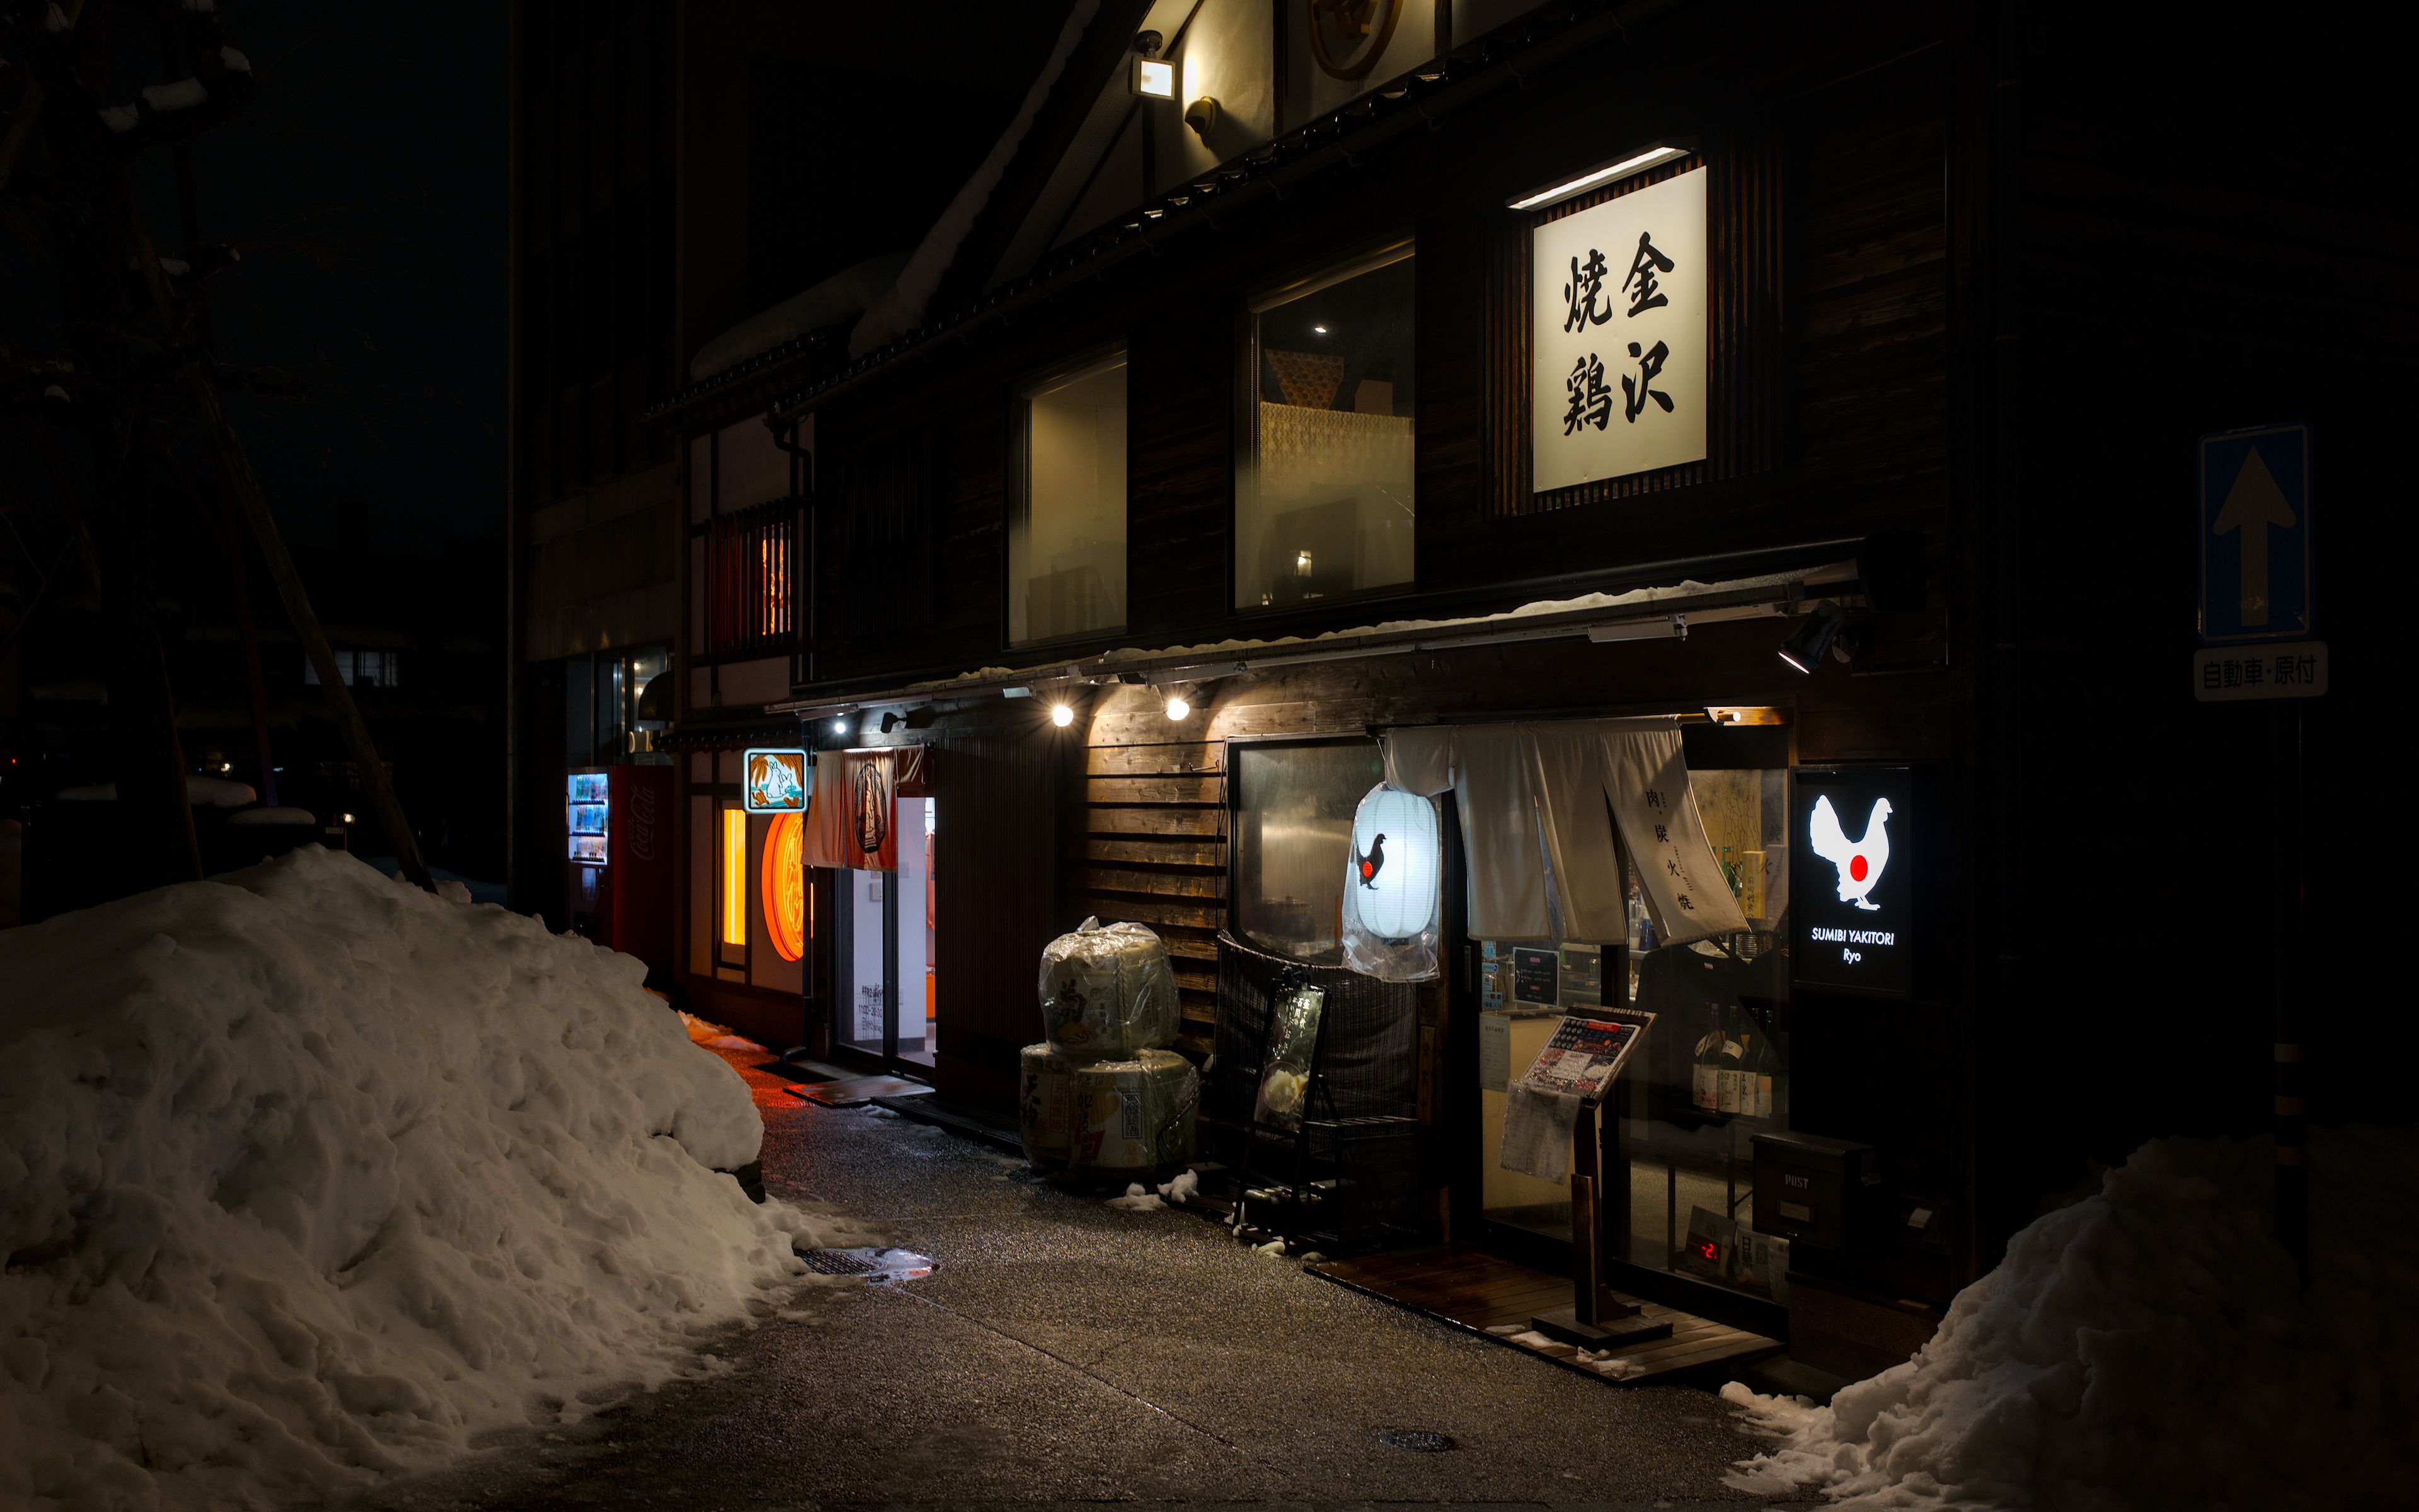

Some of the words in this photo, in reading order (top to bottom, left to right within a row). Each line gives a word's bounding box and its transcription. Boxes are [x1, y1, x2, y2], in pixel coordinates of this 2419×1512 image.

[1564, 249, 1612, 436] 焼鶏
[1622, 231, 1674, 423] 金沢
[2204, 654, 2316, 689] 自動車・原付
[630, 781, 655, 861] Coca-Cola
[1812, 927, 1846, 942] SUMIBI
[1849, 930, 1894, 946] YAKITORI
[1843, 948, 1861, 965] Ryo
[1785, 1174, 1809, 1189] POST
